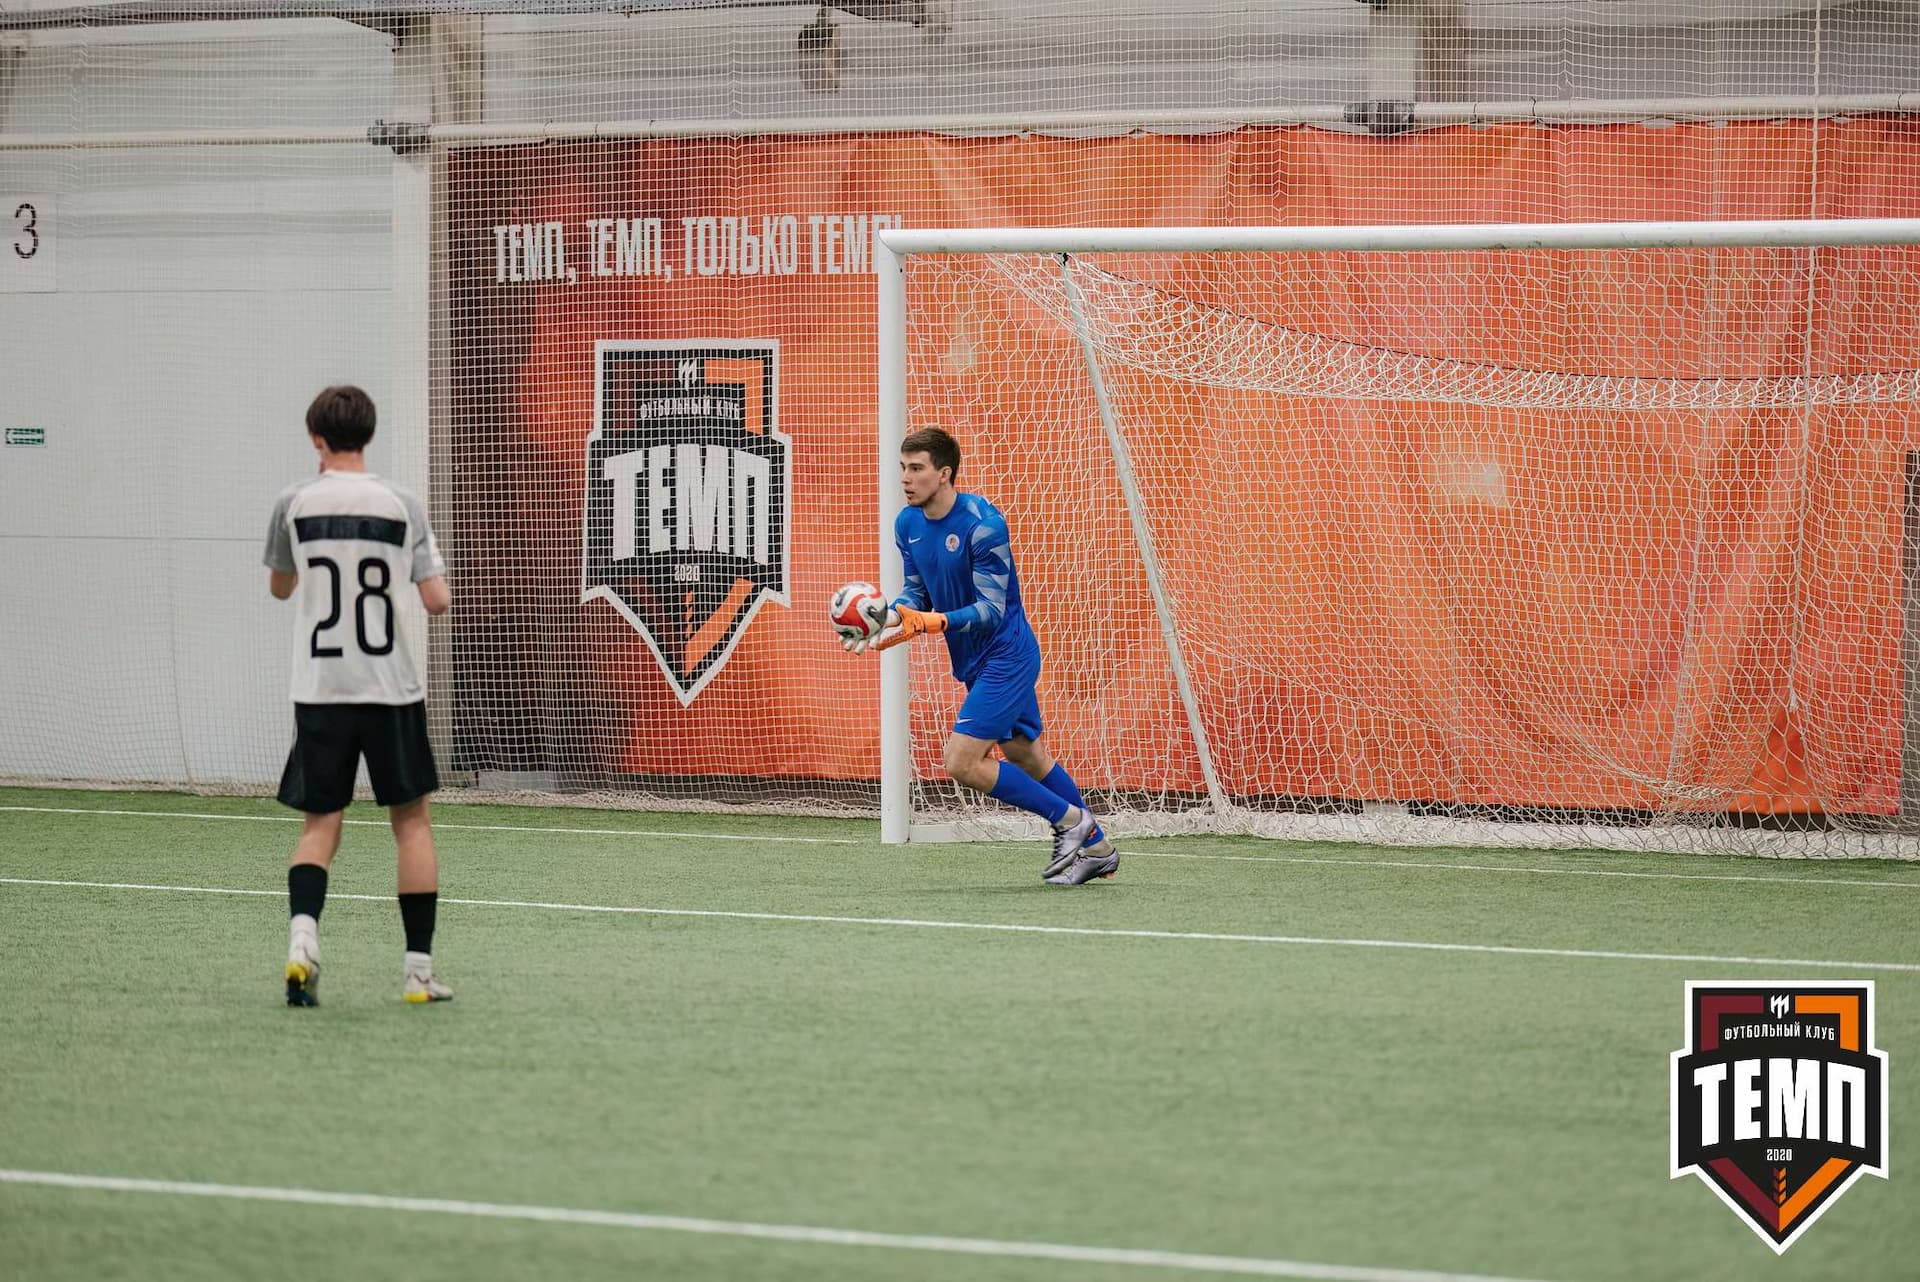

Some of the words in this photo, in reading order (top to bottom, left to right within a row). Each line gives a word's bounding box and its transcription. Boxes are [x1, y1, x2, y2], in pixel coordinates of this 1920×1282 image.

[14, 203, 39, 259] 3
[494, 221, 577, 286] ТЕМП,
[587, 217, 672, 283] ТЕМП,
[682, 215, 797, 276] ТОЛЬКО
[640, 395, 711, 419] ФУТБОЛЬНЫЙ
[716, 401, 740, 420] КЛУБ
[604, 443, 770, 566] ТЕМП
[674, 564, 700, 582] 2020
[307, 556, 394, 658] 28
